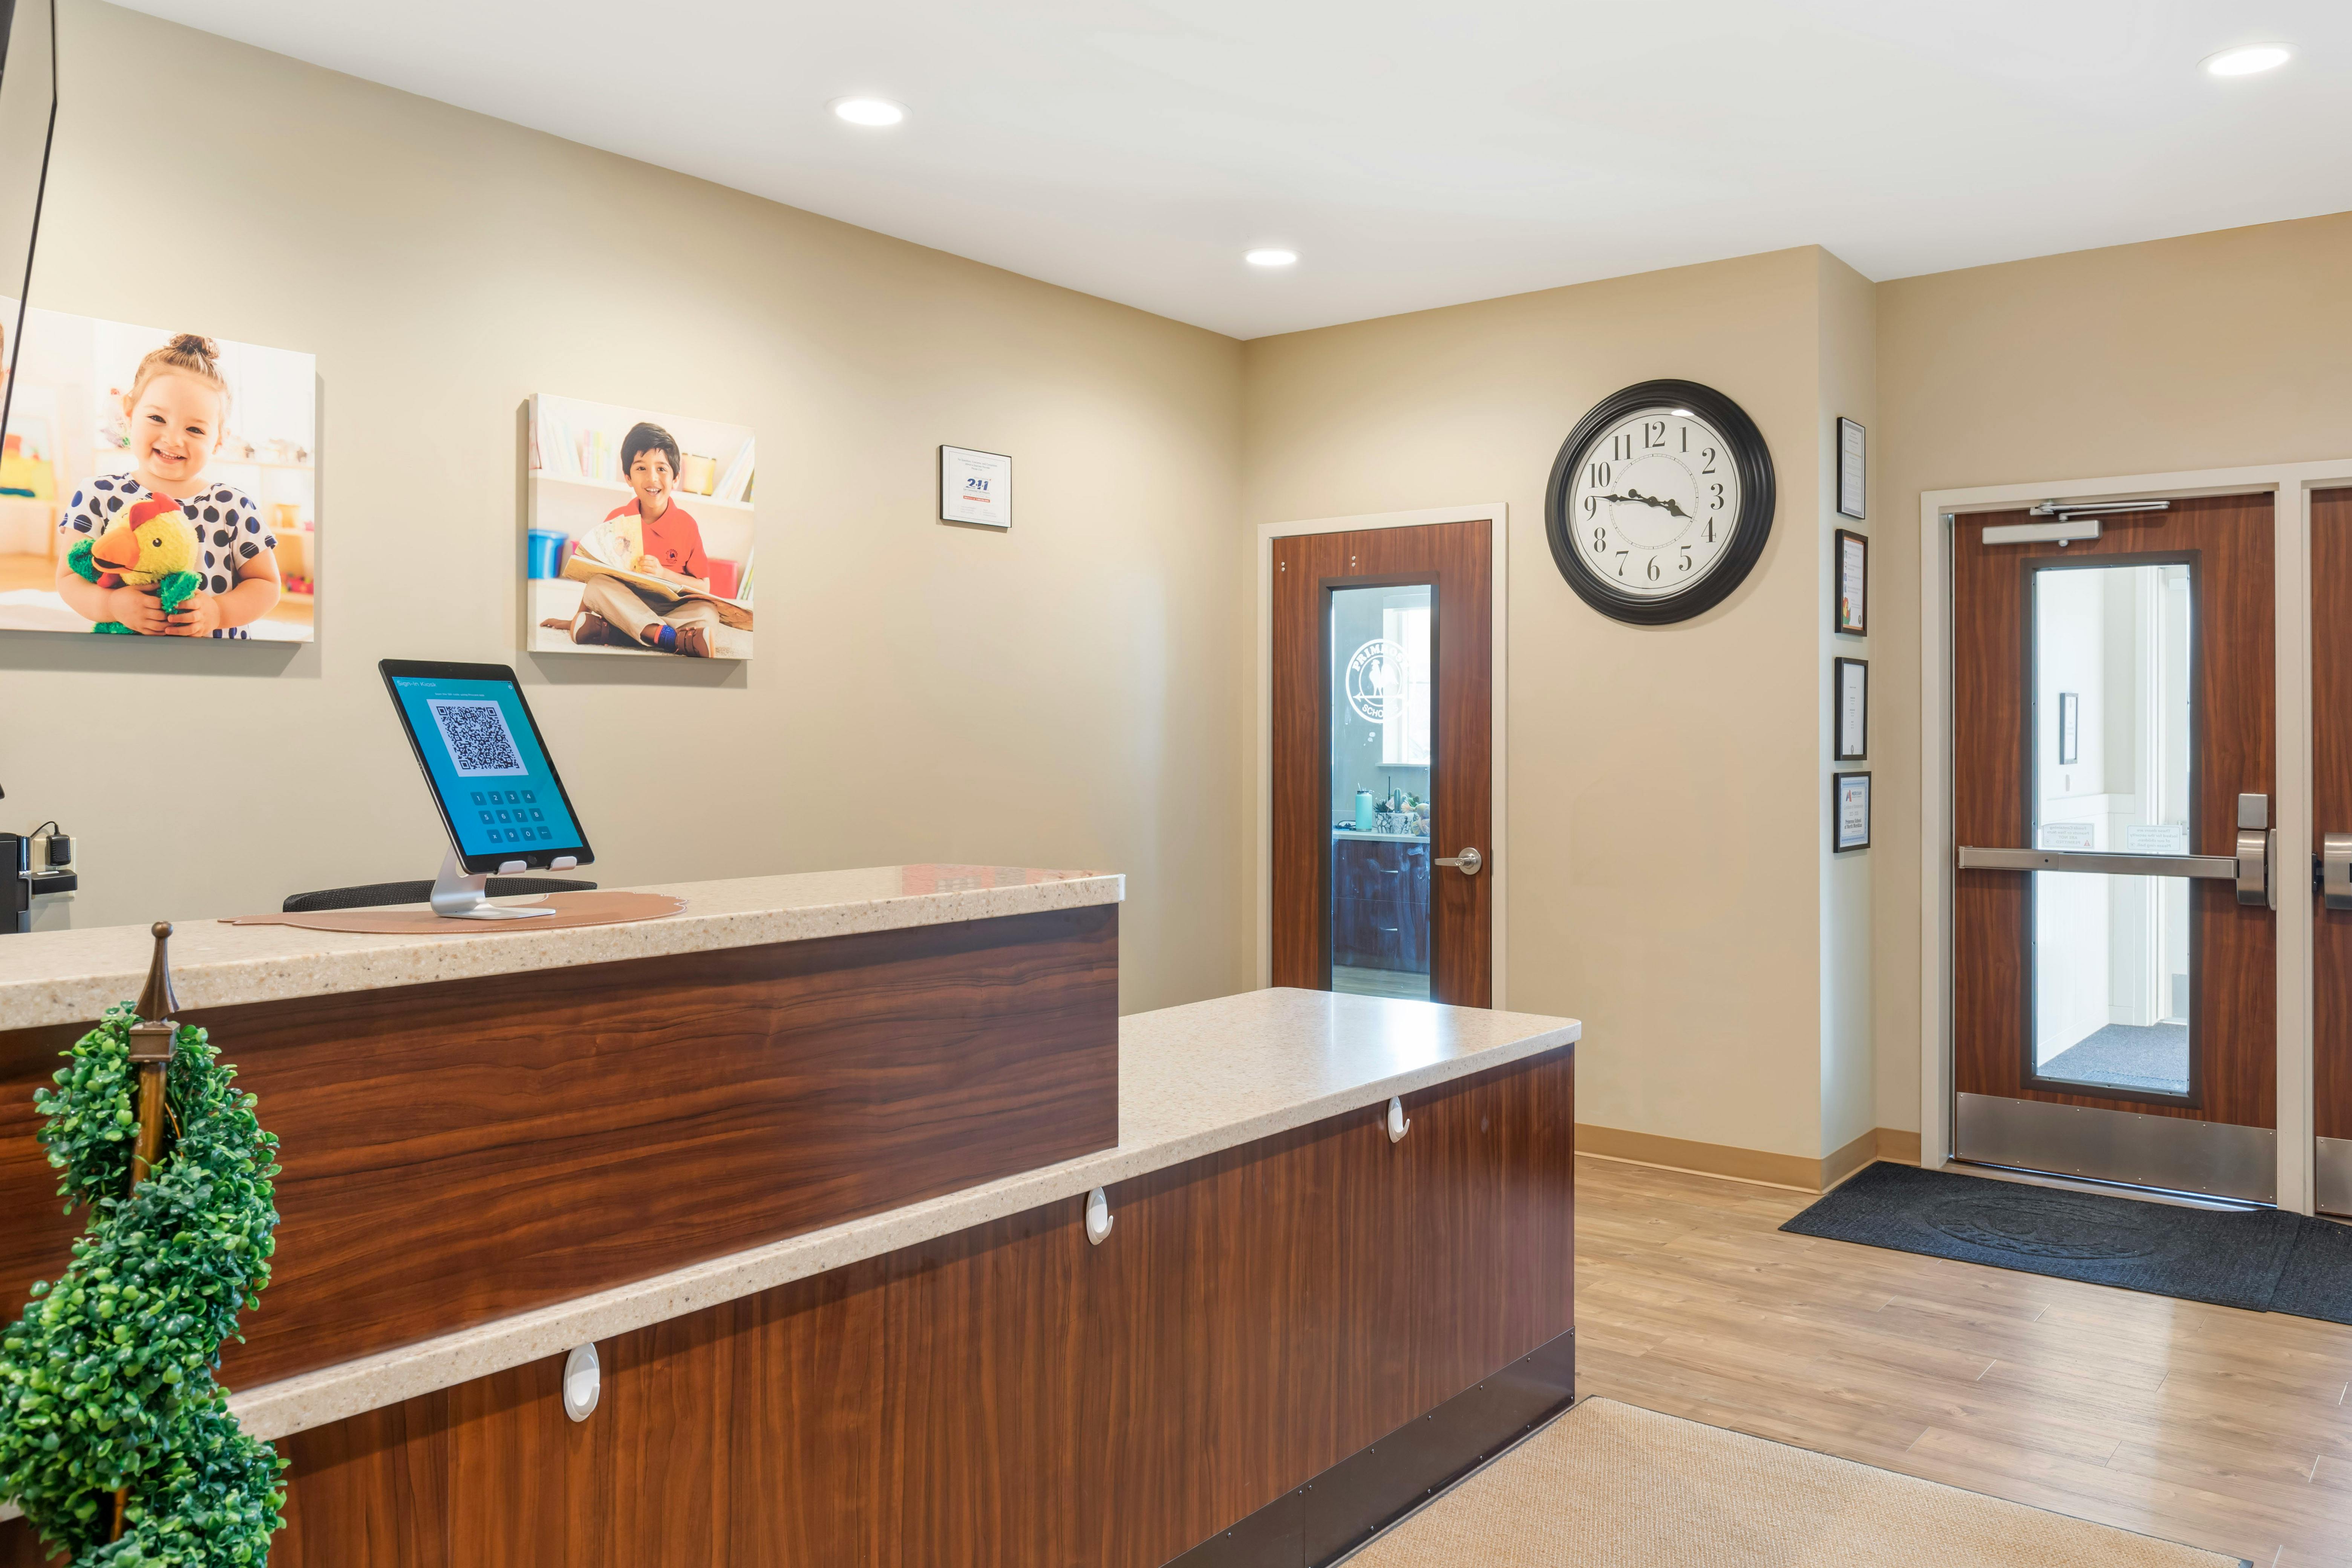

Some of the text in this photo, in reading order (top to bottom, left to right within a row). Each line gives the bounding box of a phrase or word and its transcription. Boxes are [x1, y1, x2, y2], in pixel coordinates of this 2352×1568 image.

[1612, 434, 1633, 461] 11
[1642, 421, 1665, 449] 12
[1680, 427, 1689, 453] 1
[1702, 448, 1716, 474] 2
[1588, 462, 1611, 488] 10
[1585, 496, 1596, 521] 9
[1710, 484, 1724, 510] 3
[1594, 527, 1606, 553] 8
[1701, 516, 1716, 543] 4
[1615, 551, 1629, 576] 7
[1647, 555, 1660, 581] 6
[1679, 545, 1692, 571] 5
